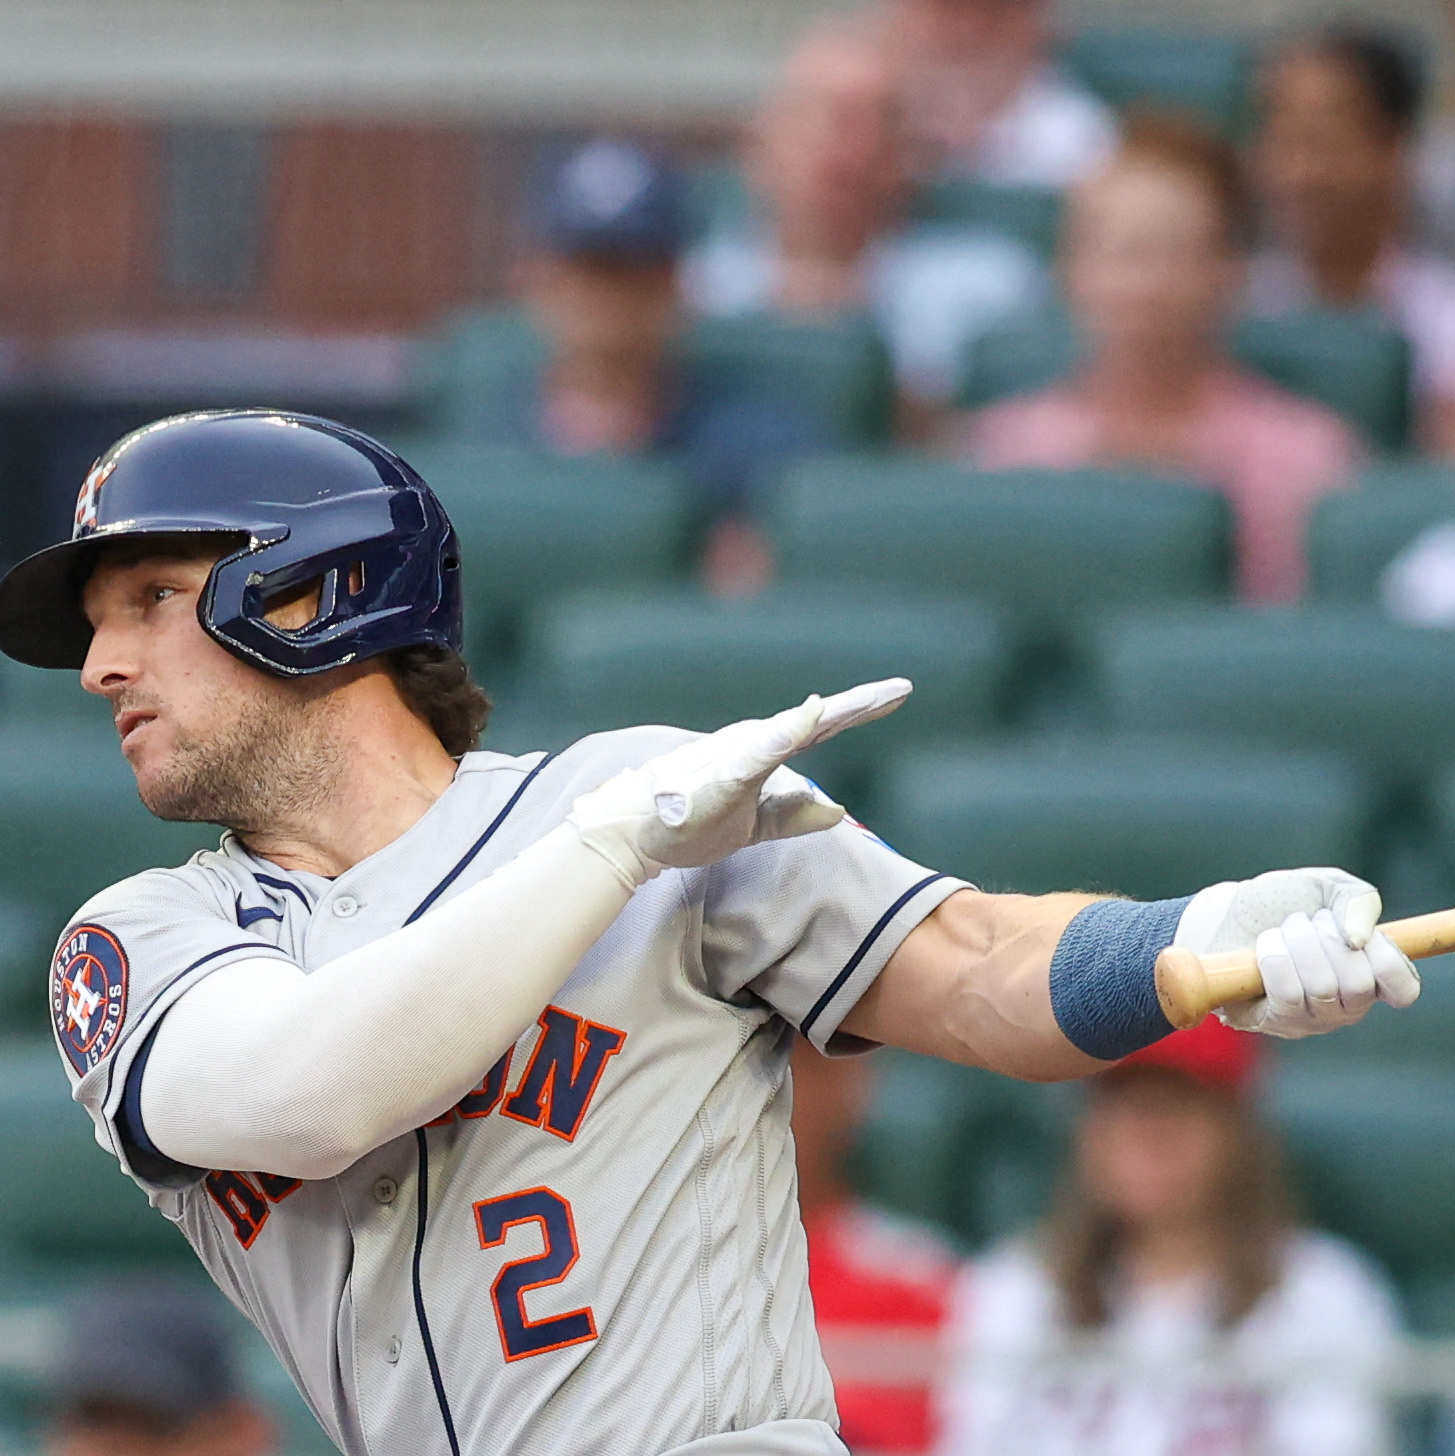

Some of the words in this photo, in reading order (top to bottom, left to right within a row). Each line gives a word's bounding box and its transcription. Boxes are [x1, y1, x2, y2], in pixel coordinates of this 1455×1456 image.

[54, 933, 89, 1033] HOUSTON
[85, 984, 122, 1073] ASTROS
[472, 1185, 599, 1364] 2
